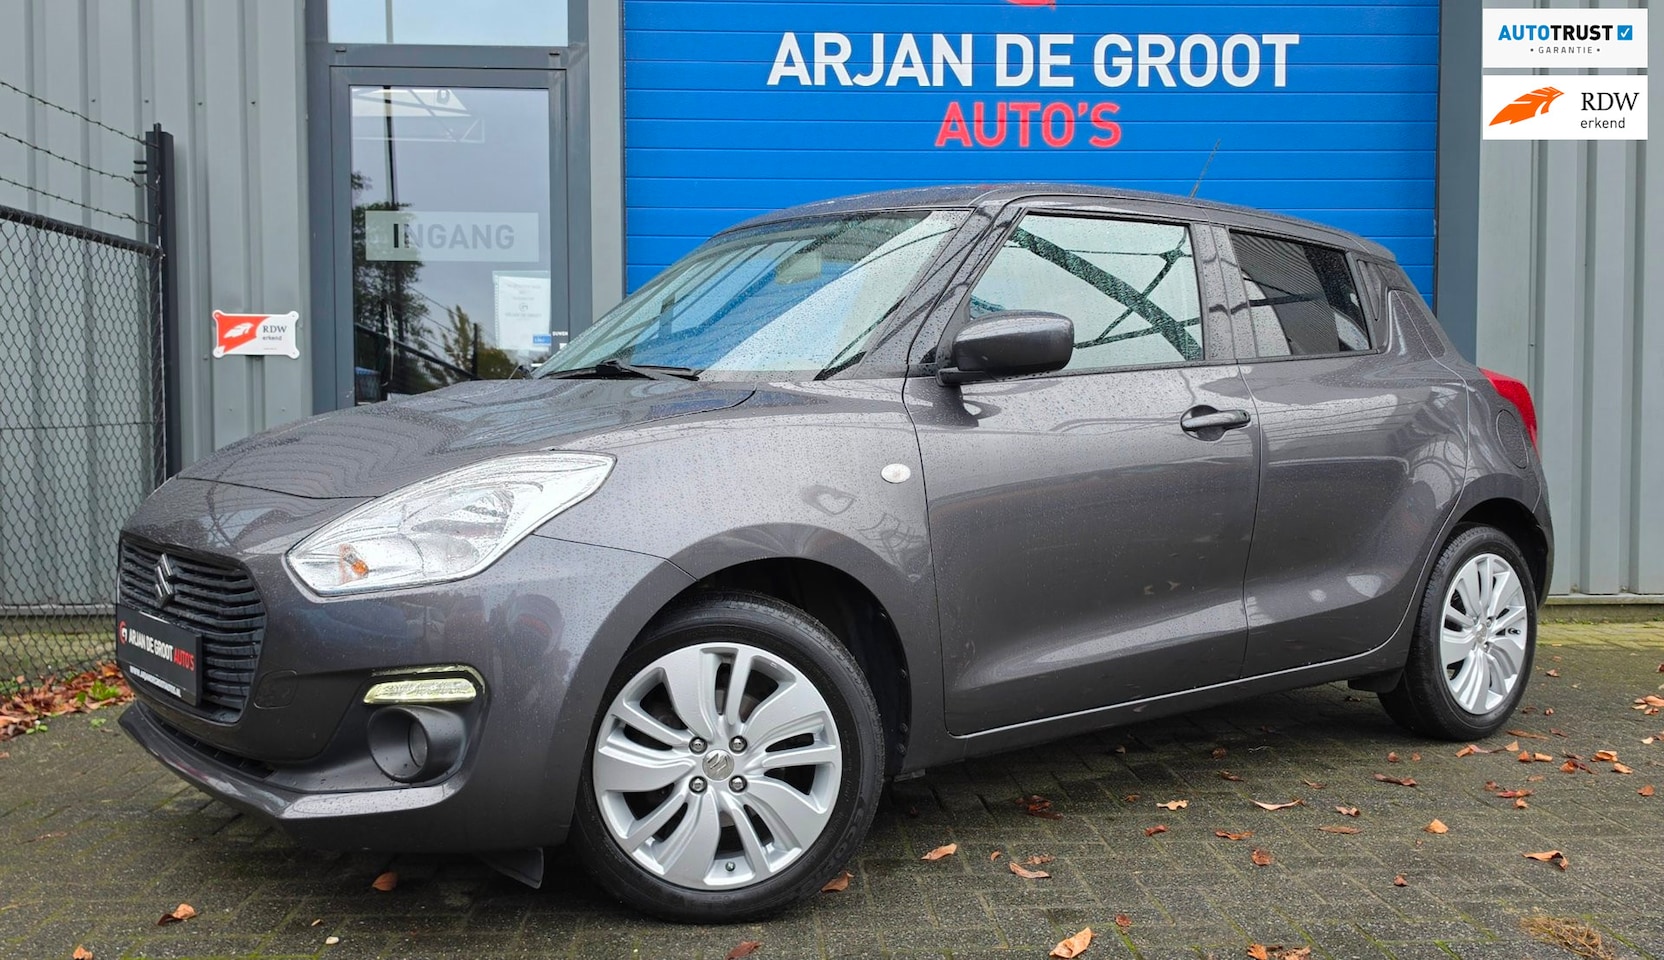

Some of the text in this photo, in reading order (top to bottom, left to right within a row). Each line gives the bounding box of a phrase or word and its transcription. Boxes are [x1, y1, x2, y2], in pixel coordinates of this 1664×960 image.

[766, 32, 1300, 88] ARJAN DE GROOT
[934, 101, 1123, 148] AUTO'S
[393, 223, 515, 250] INGANG
[262, 325, 287, 333] RDW
[129, 628, 146, 650] ARJAN
[146, 635, 154, 654] DE
[154, 639, 173, 662] GROOT
